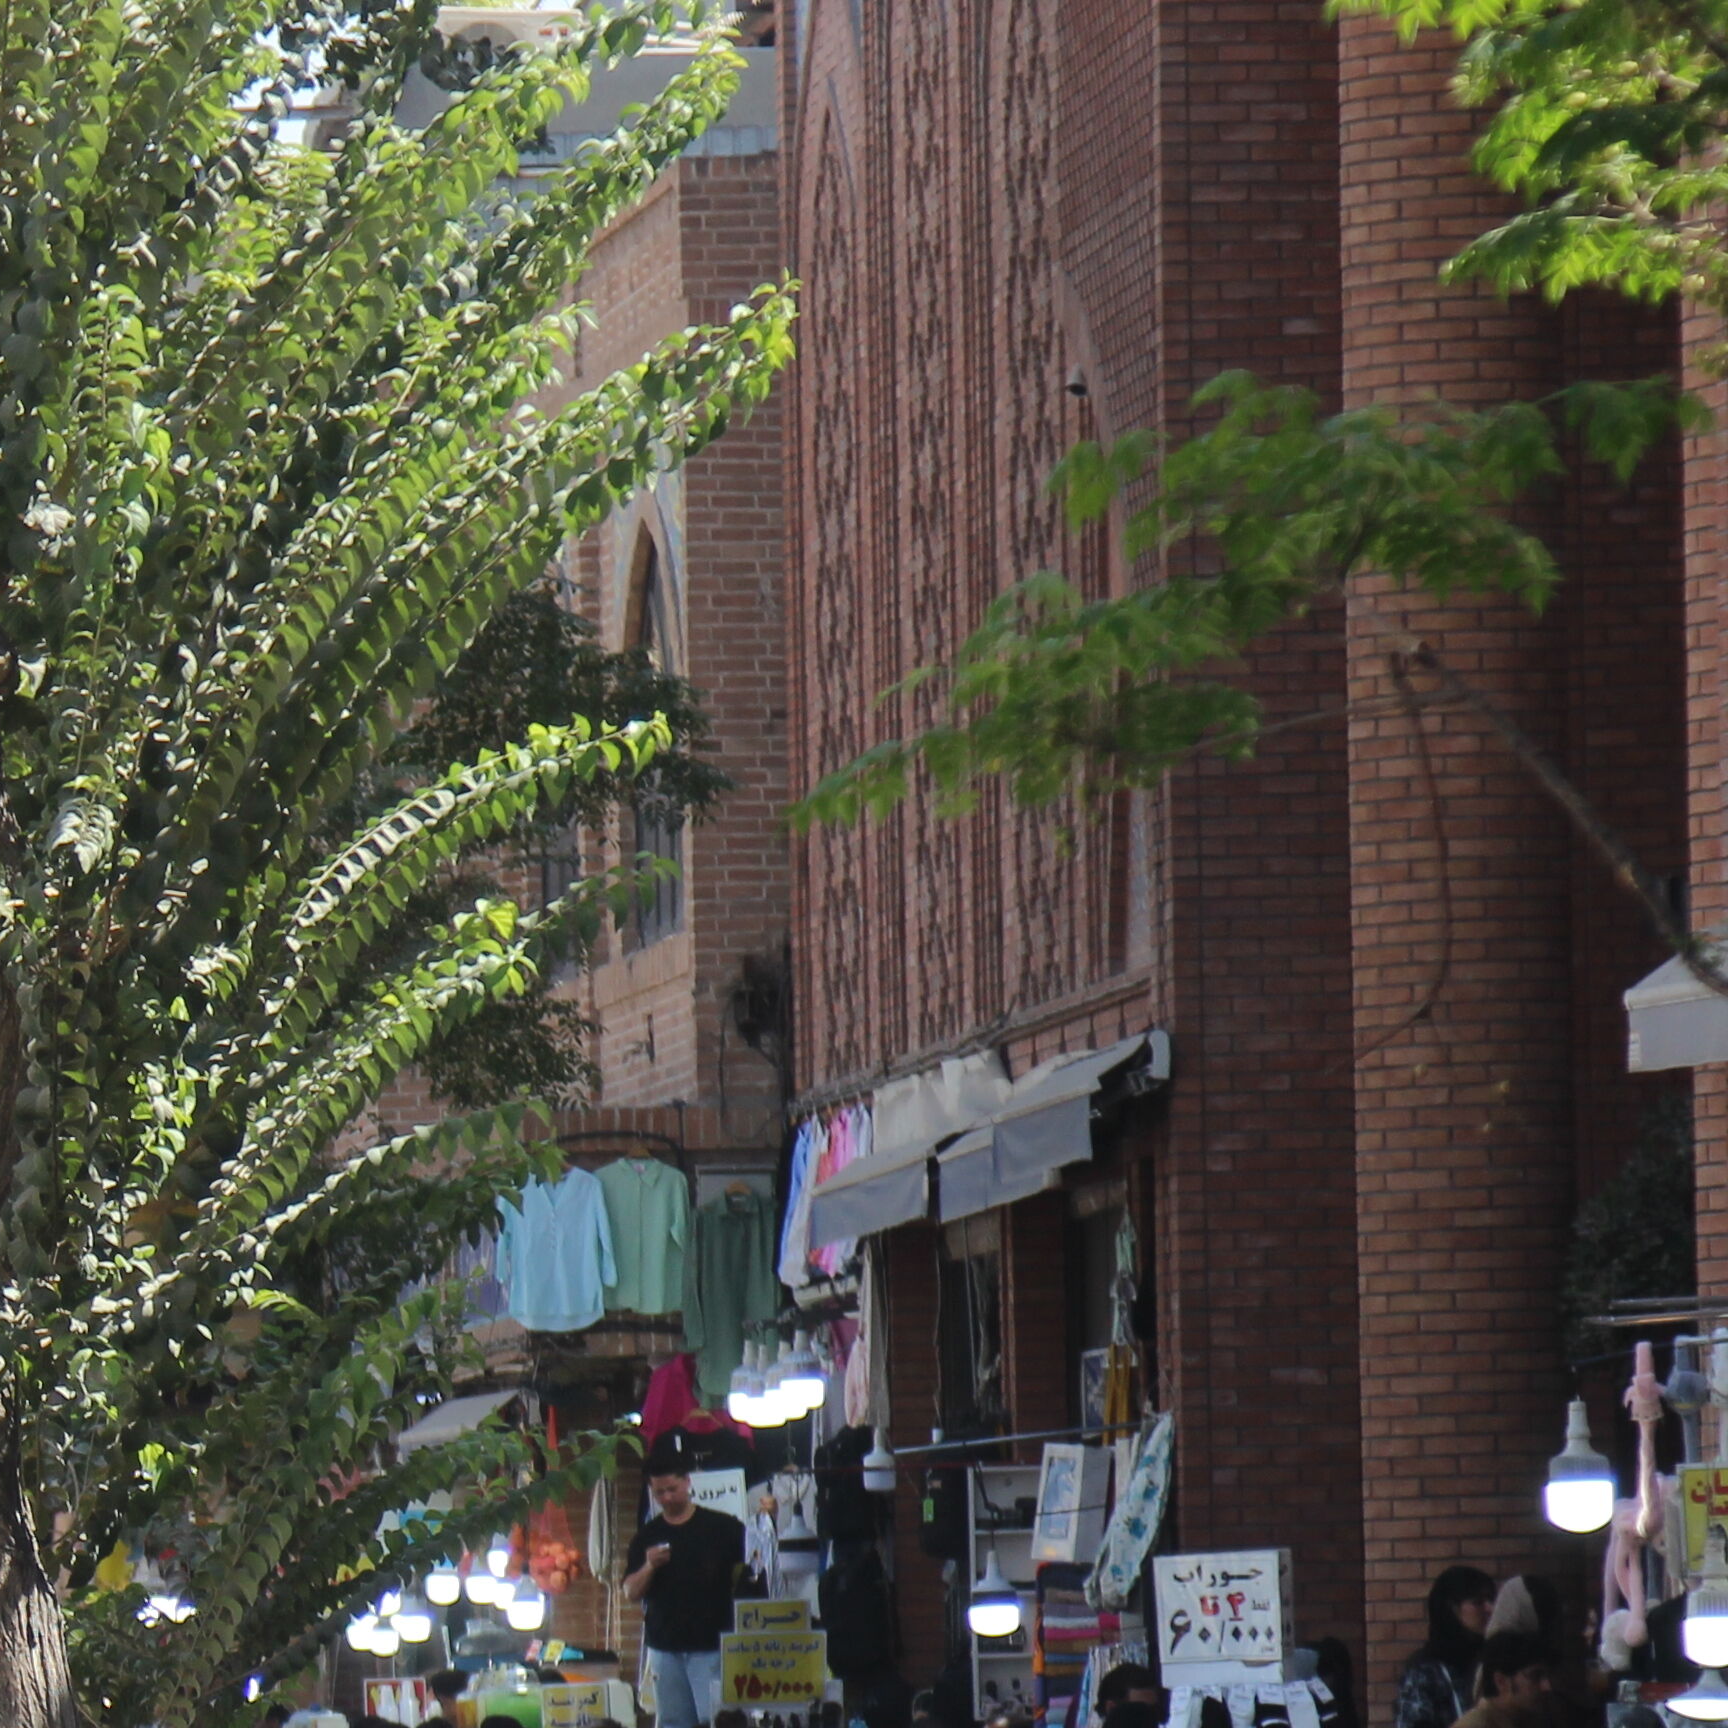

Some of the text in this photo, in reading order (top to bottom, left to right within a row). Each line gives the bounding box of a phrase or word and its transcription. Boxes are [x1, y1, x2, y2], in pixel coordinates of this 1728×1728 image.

[1172, 1563, 1263, 1588] جوراب
[1199, 1594, 1221, 1617] تا
[742, 1608, 801, 1630] حراج
